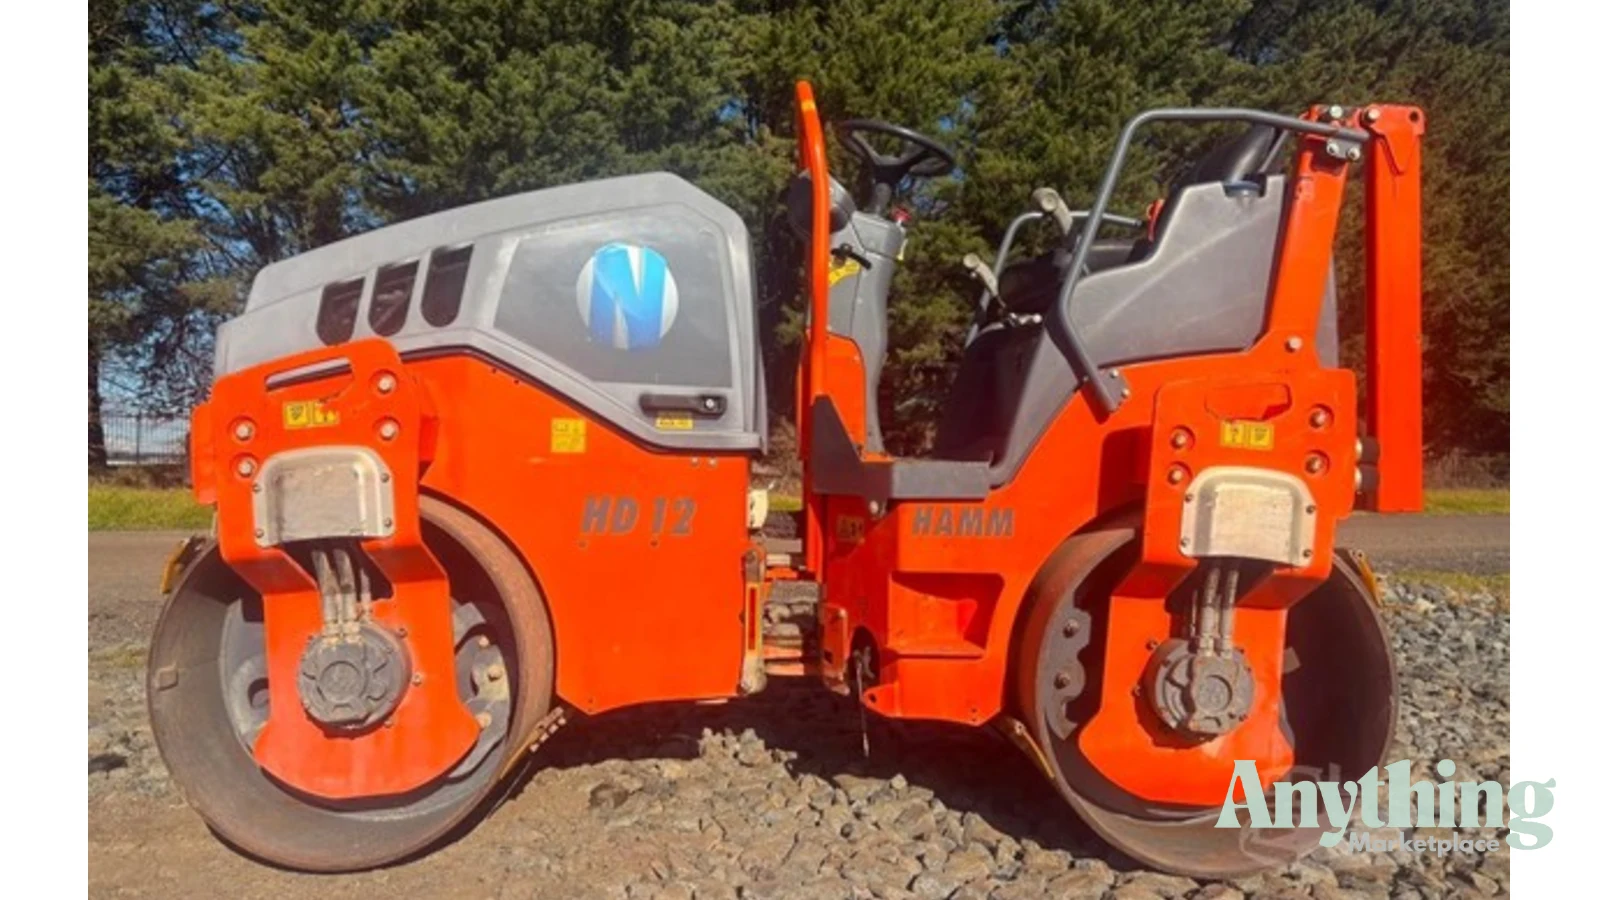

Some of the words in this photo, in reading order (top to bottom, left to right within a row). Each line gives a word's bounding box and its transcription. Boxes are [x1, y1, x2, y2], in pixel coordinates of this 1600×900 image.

[588, 242, 668, 351] N
[581, 495, 638, 534] HD
[651, 496, 695, 535] 12
[911, 507, 1014, 537] HAMM
